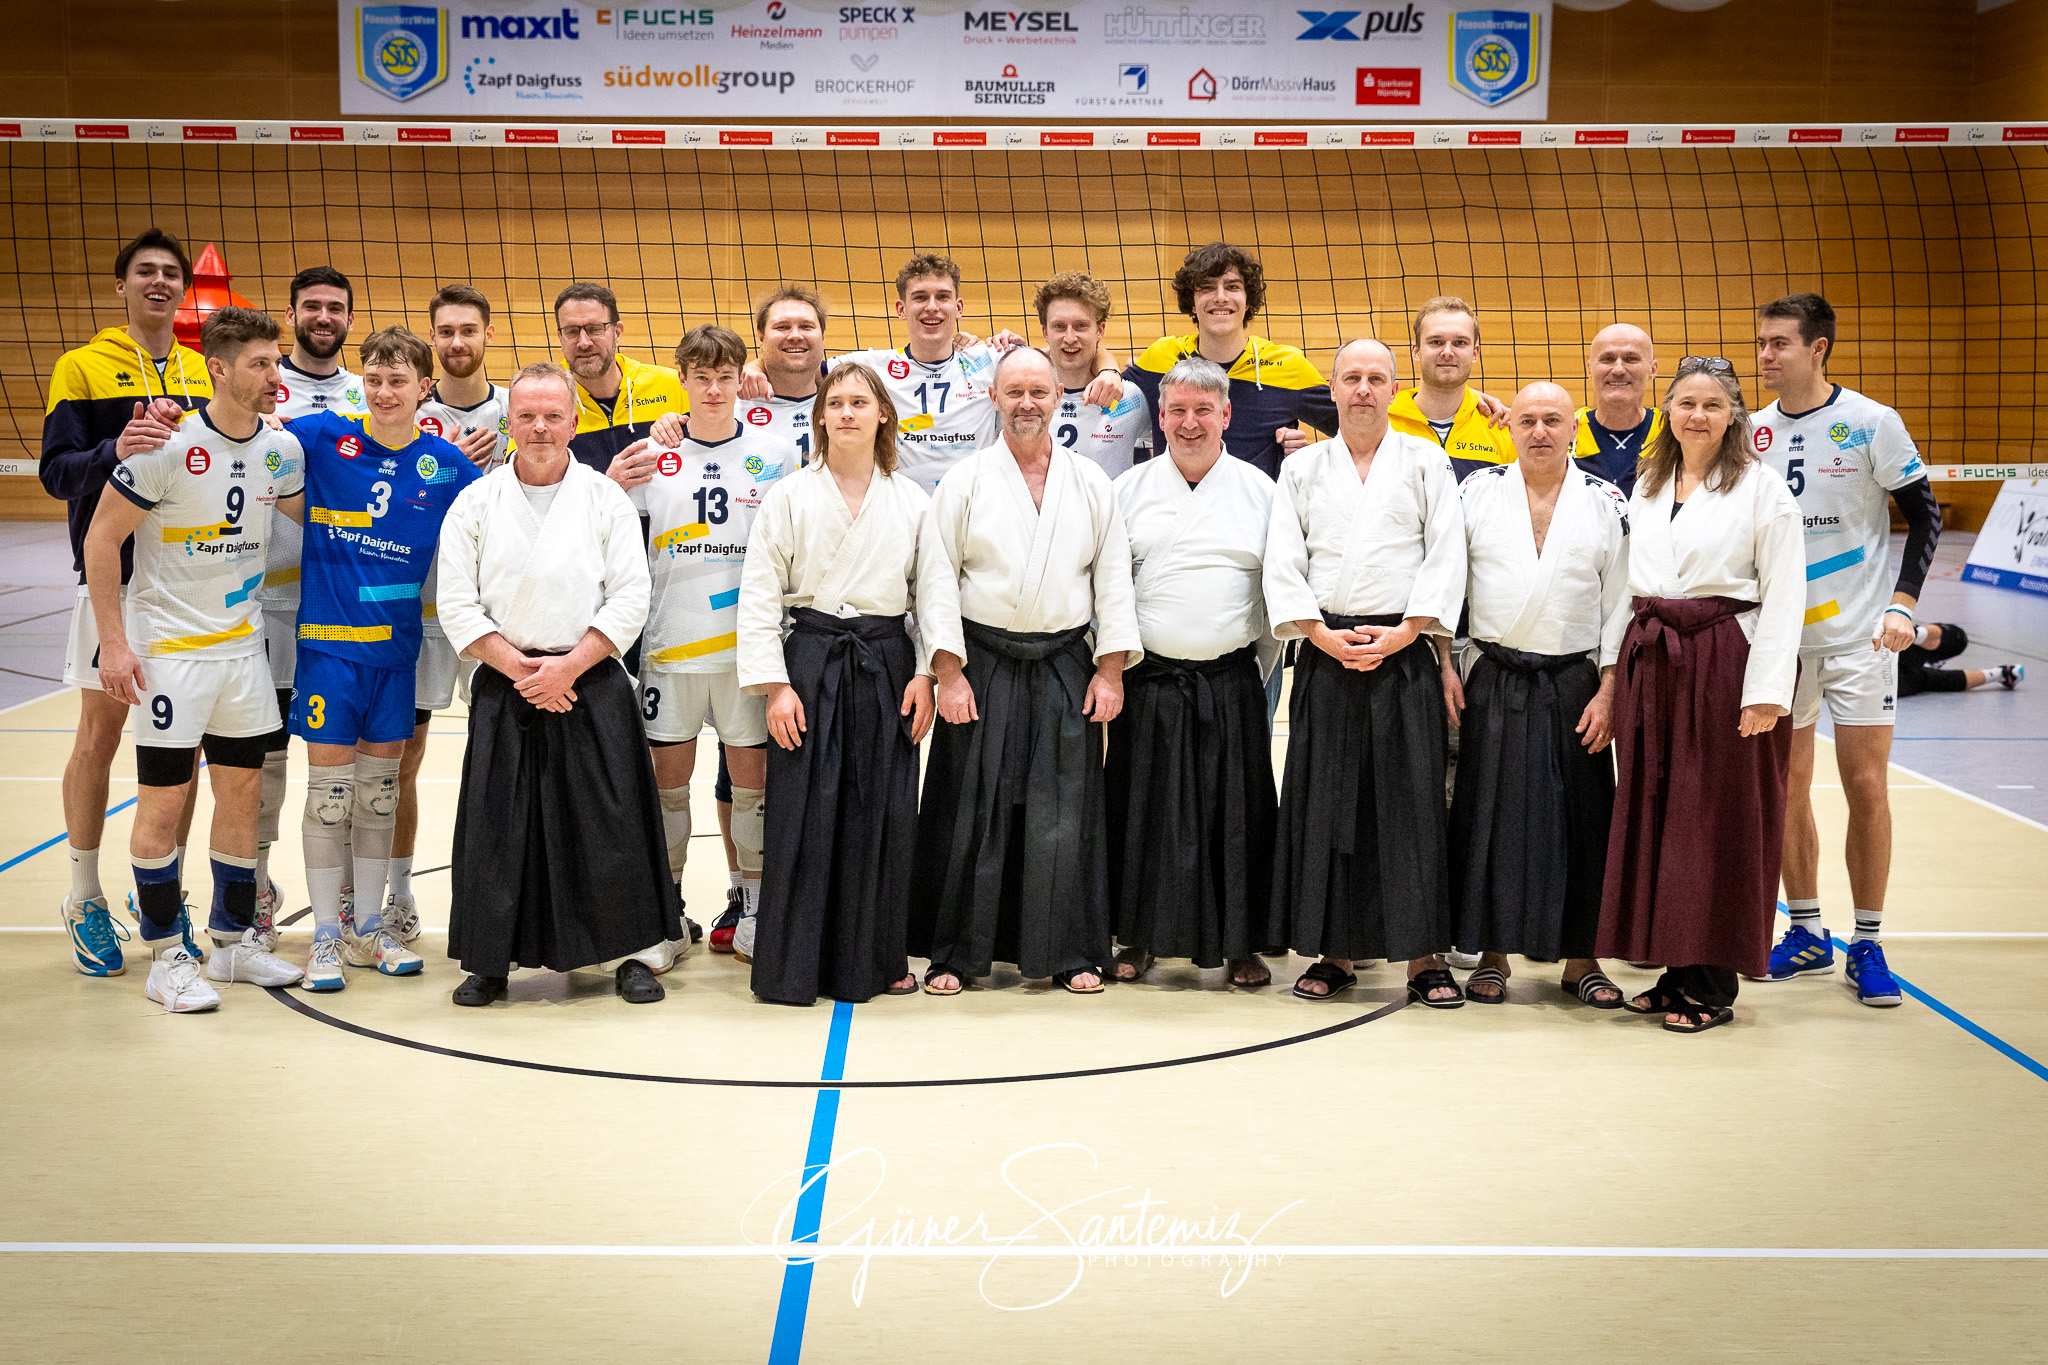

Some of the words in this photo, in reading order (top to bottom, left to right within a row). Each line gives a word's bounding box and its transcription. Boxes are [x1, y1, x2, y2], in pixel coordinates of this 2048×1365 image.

[624, 9, 714, 25] FUCHS
[839, 7, 896, 24] SPECK
[964, 11, 1078, 32] MEYSEL
[461, 8, 579, 40] maxit
[731, 25, 823, 38] Heinzelmann
[624, 29, 655, 41] Ideen
[658, 30, 714, 41] umsetzen
[839, 26, 898, 41] pumpen
[964, 35, 993, 45] Druck
[1006, 35, 1077, 45] Werbetechnik
[760, 41, 794, 50] Medien
[478, 74, 512, 89] Zapf
[516, 74, 582, 90] Daigfuss
[815, 79, 915, 94] BROCKERHOF
[1377, 79, 1413, 89] Sparkasse
[974, 93, 1045, 105] SERVICES
[636, 394, 667, 407] Schwaig
[914, 382, 950, 414] 17
[1057, 423, 1078, 448] 2
[1456, 442, 1467, 450] SV
[1788, 444, 1804, 452] errea
[378, 467, 396, 476] errea
[703, 472, 721, 480] errea
[1786, 458, 1805, 497] 5
[1964, 468, 2016, 478] FUCHS
[225, 486, 244, 524] 9
[367, 481, 392, 518] 3
[693, 486, 729, 525] 13
[1803, 516, 1840, 528] igfuss
[196, 541, 224, 555] Zapf
[336, 527, 360, 544] Zapf
[361, 534, 411, 555] Daigfuss
[676, 543, 702, 556] Zapf
[704, 543, 747, 556] Daigfus
[151, 694, 173, 730] 9
[307, 694, 326, 729] 3
